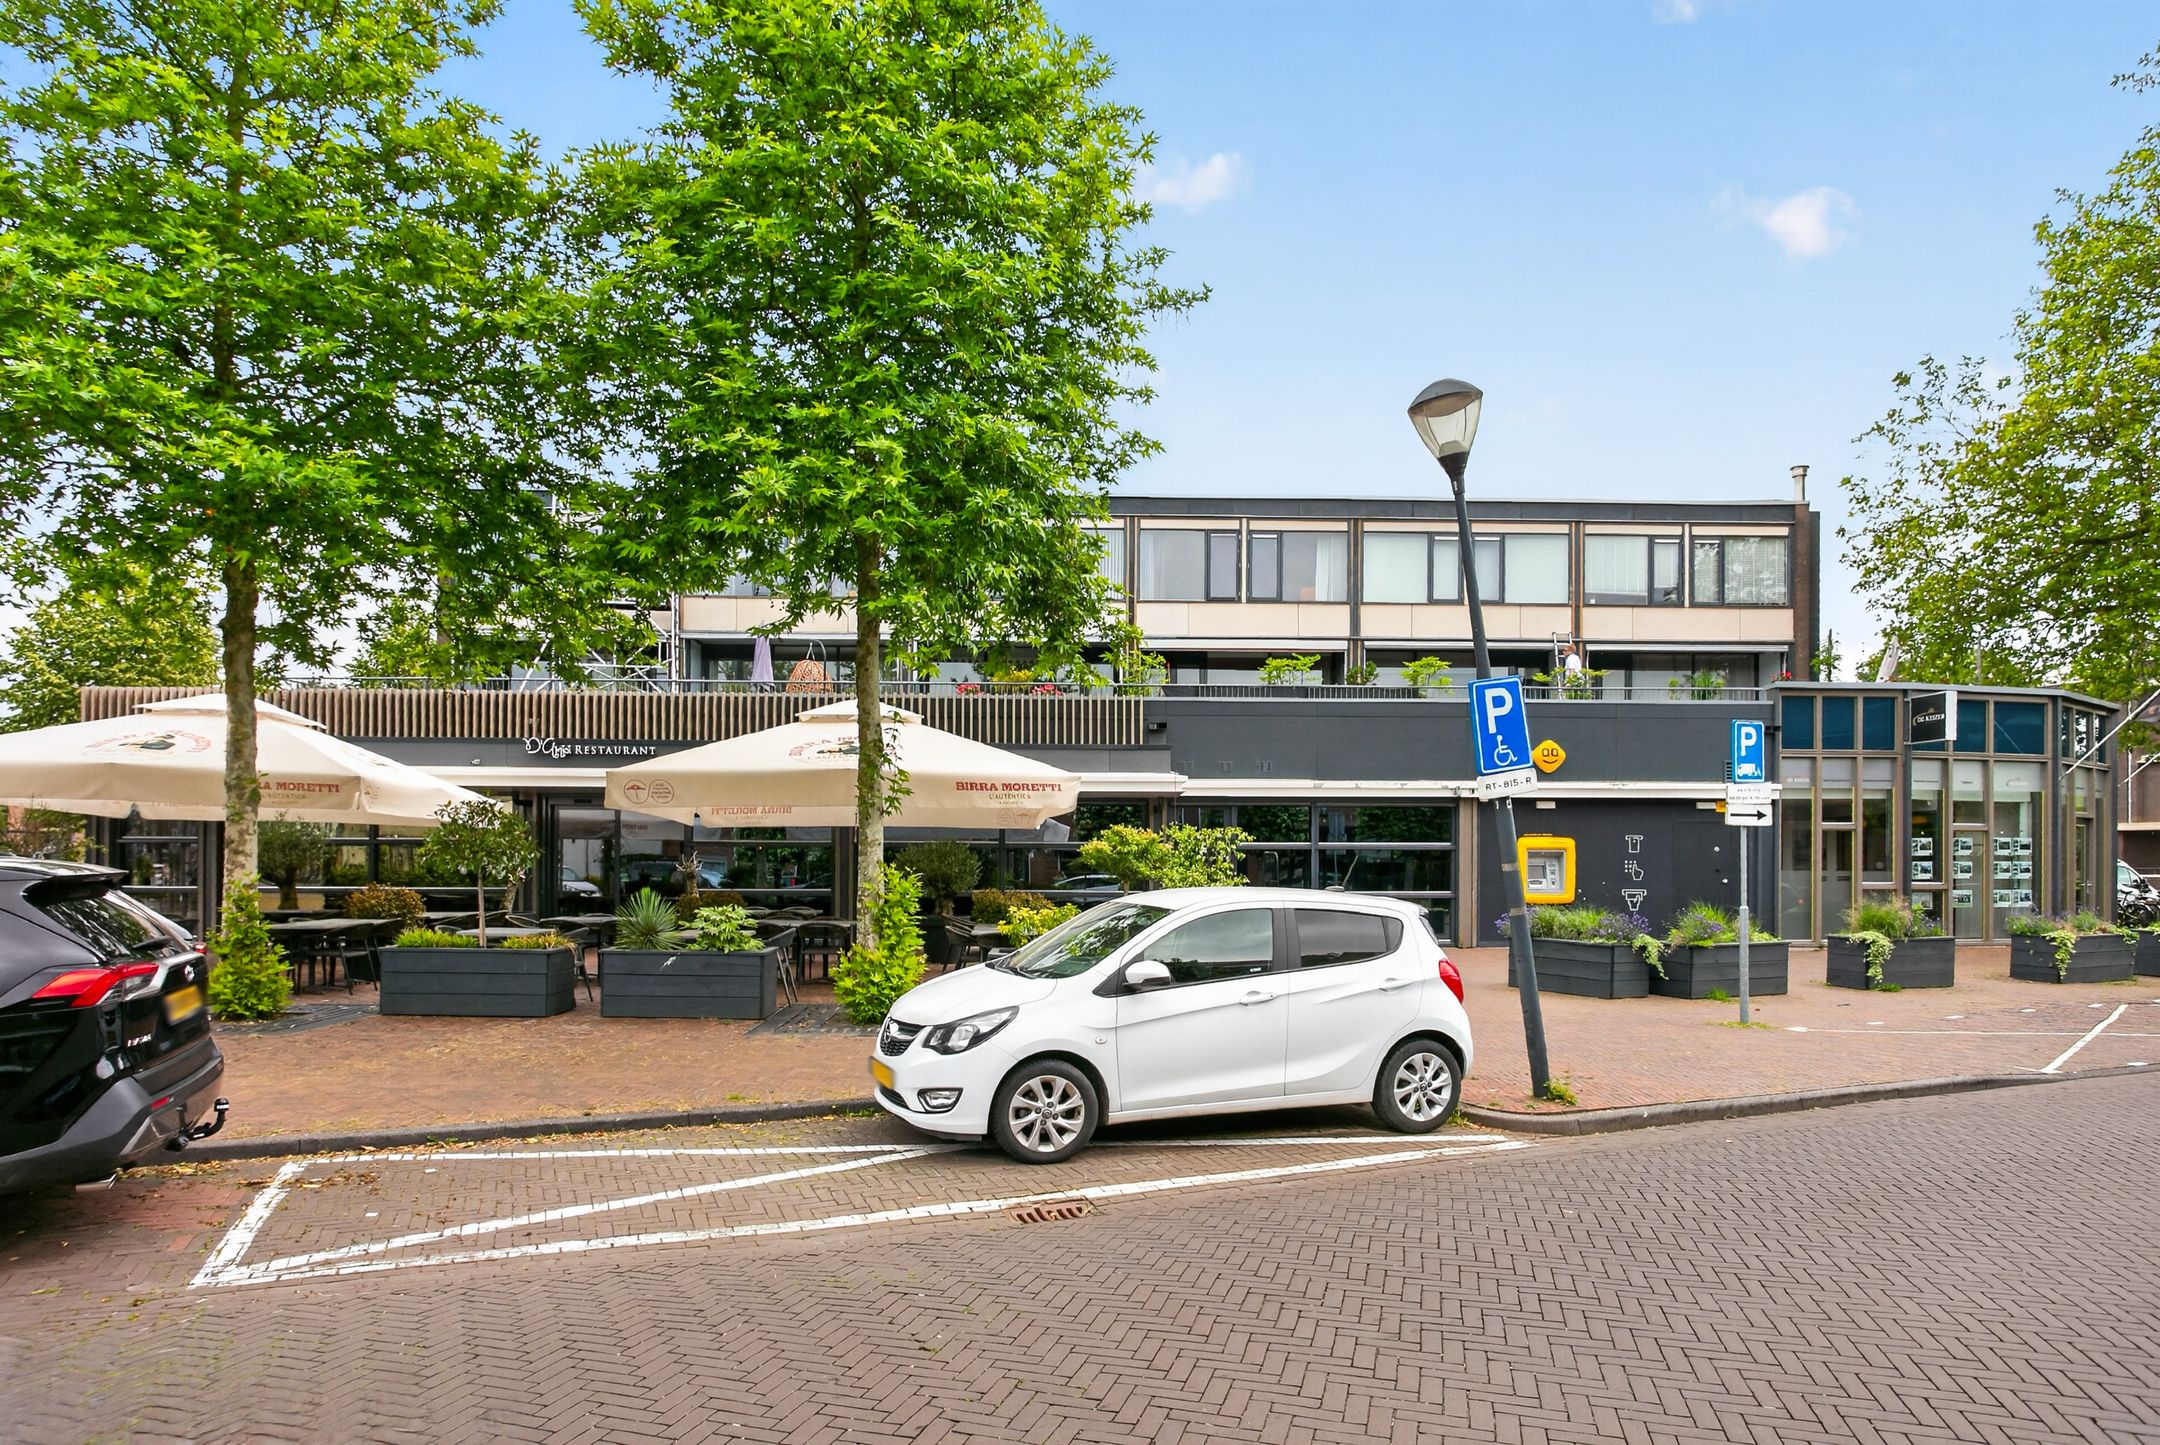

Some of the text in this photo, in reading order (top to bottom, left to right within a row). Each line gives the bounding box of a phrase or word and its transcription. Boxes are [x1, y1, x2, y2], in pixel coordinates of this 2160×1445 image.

[1484, 687, 1513, 734] P
[1741, 726, 1757, 757] P
[276, 781, 341, 793] MORETTI
[956, 781, 1062, 792] BIRRA MORETTI
